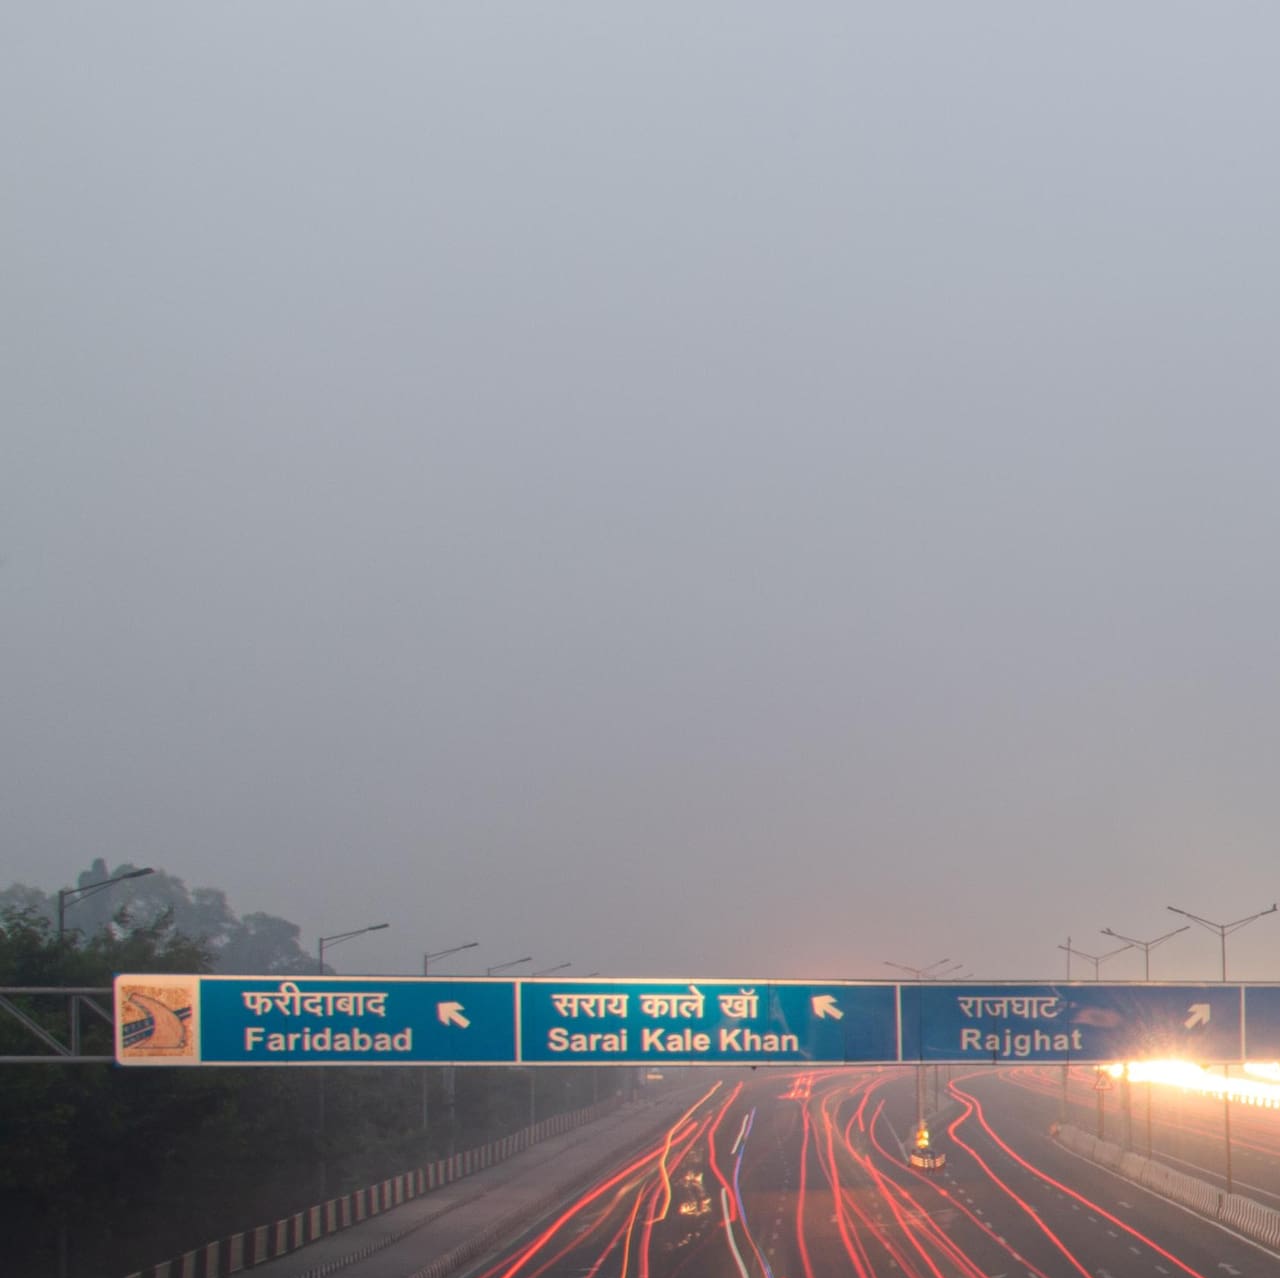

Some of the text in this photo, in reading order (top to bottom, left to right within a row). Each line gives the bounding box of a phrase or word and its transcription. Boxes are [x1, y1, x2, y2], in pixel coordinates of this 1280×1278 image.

[241, 982, 389, 1017] फरीदाबाद
[551, 994, 629, 1019] सराय
[639, 985, 705, 1019] काले
[958, 996, 1060, 1019] राजघाट
[245, 1027, 412, 1052] Faridabad
[548, 1027, 799, 1053] Sarai Kale Khan
[960, 1028, 1083, 1056] Rajghat
